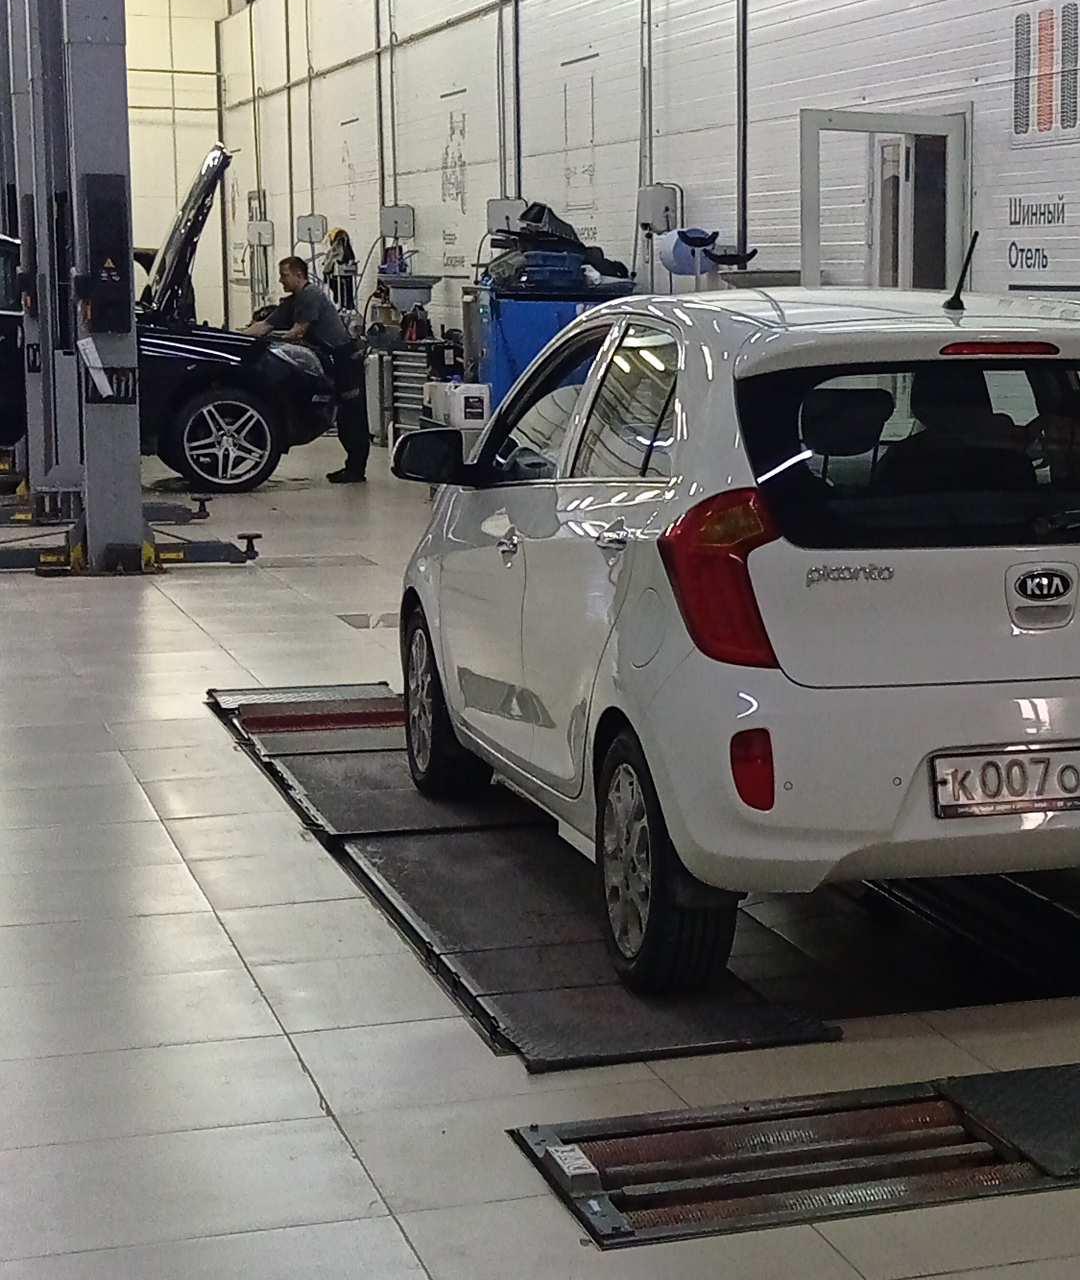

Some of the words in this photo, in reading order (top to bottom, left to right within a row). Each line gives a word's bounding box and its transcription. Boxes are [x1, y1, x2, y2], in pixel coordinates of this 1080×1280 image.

[1009, 194, 1065, 226] Шинный
[1008, 241, 1048, 269] Отель
[1026, 578, 1064, 595] KIA
